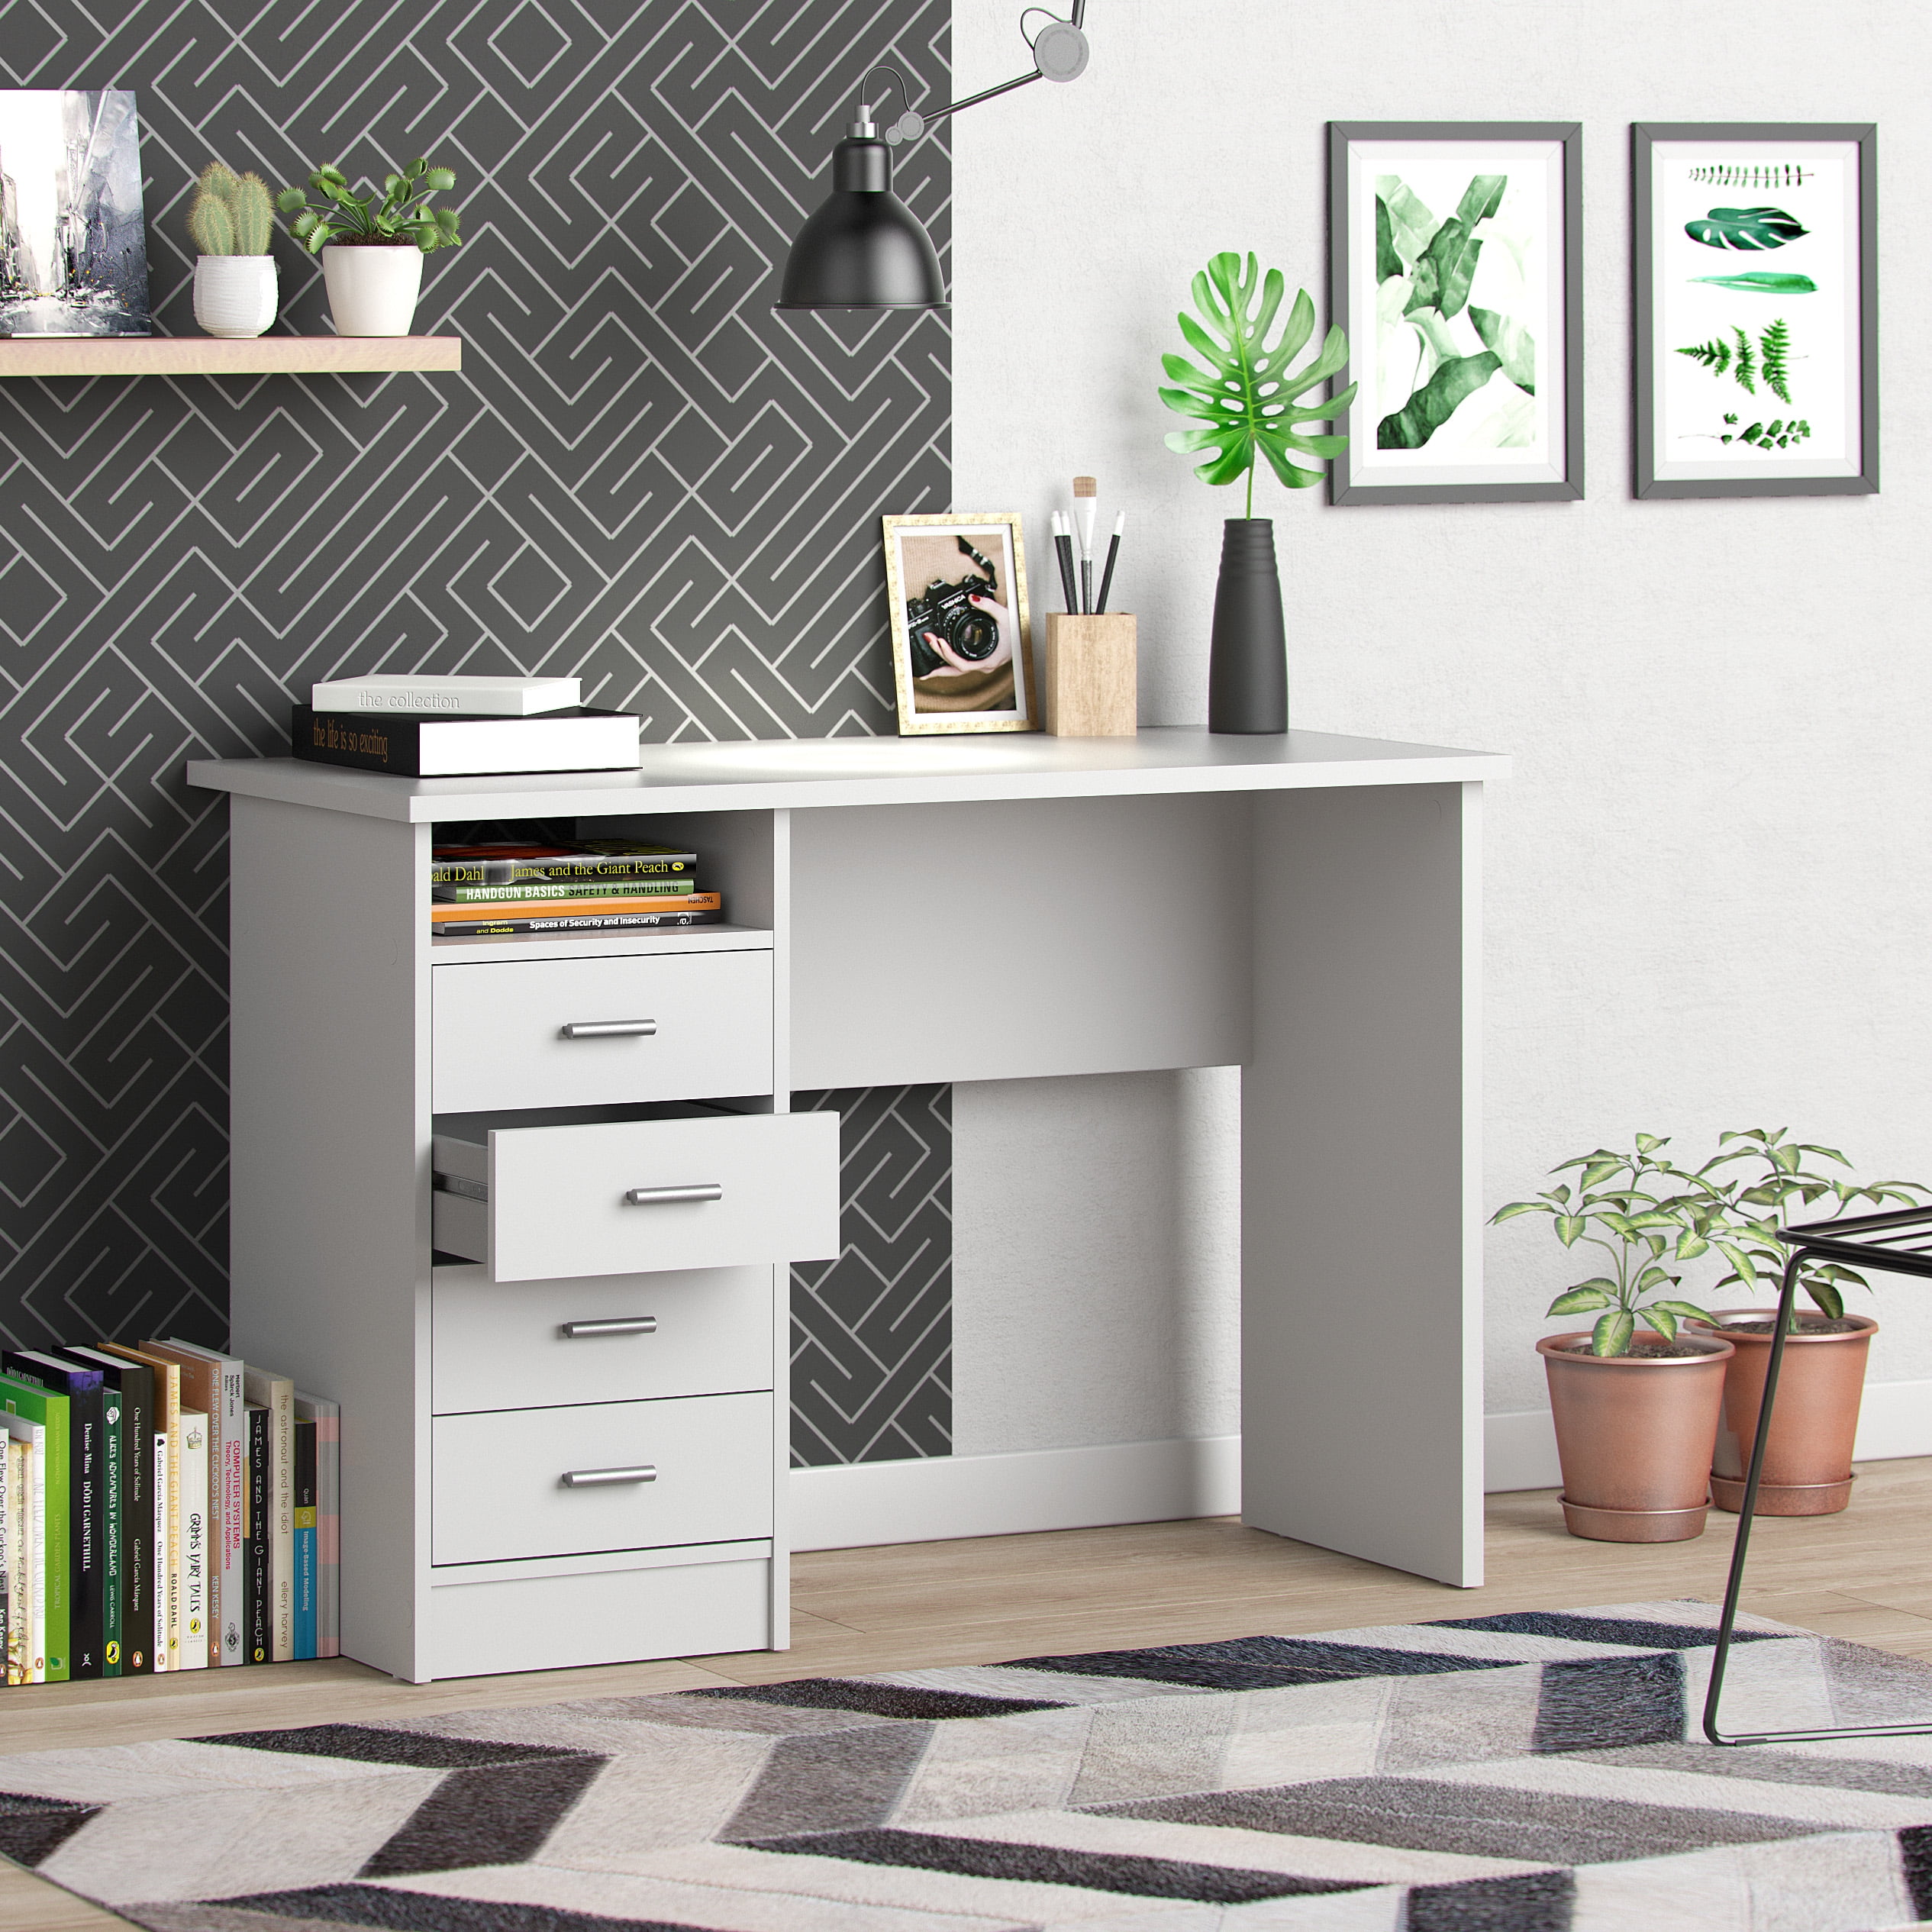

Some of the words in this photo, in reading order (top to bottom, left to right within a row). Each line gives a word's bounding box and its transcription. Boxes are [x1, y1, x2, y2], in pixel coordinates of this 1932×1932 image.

[358, 690, 382, 707] the
[388, 691, 460, 708] collection
[314, 718, 325, 746] the
[327, 718, 338, 749] life
[340, 724, 347, 750] is
[349, 732, 357, 751] so
[360, 729, 388, 763] exciting
[455, 866, 485, 881] Dahl
[508, 864, 545, 882] James
[549, 863, 571, 876] and
[575, 861, 593, 876] the
[597, 861, 631, 876] Giant
[634, 860, 669, 874] Peach
[466, 886, 521, 900] HANDGUN
[524, 885, 565, 898] BASICS
[569, 883, 607, 896] SAFETY
[611, 883, 619, 895] &
[623, 881, 679, 894] HANDLING
[688, 896, 714, 905] TASCHEN
[529, 921, 558, 930] Spaces
[559, 919, 568, 927] of
[569, 918, 603, 929] Security
[604, 917, 619, 926] and
[620, 915, 660, 927] Insecurity
[169, 1375, 179, 1415] JAMES
[281, 1395, 289, 1411] the
[84, 1423, 92, 1451] Denise
[169, 1421, 179, 1448] AND
[281, 1414, 289, 1464] astronaut
[84, 1453, 92, 1474] Mina
[169, 1453, 179, 1479] THE
[82, 1481, 92, 1503] DÖD
[281, 1469, 289, 1489] and
[169, 1481, 179, 1518] GIANT
[281, 1492, 289, 1508] the
[155, 1501, 163, 1533] Márquez
[281, 1512, 289, 1534] idiot
[82, 1509, 91, 1572] GARNETHILL
[109, 1522, 118, 1576] WONDERLAND
[170, 1525, 179, 1567] PEACH
[186, 1553, 202, 1579] FAIRY
[254, 1545, 264, 1595] GIANT
[132, 1584, 141, 1612] Márquez
[189, 1581, 202, 1612] TALES
[279, 1581, 289, 1609] ellery
[156, 1609, 163, 1618] of
[254, 1599, 263, 1646] PEACH
[279, 1613, 289, 1648] harvey
